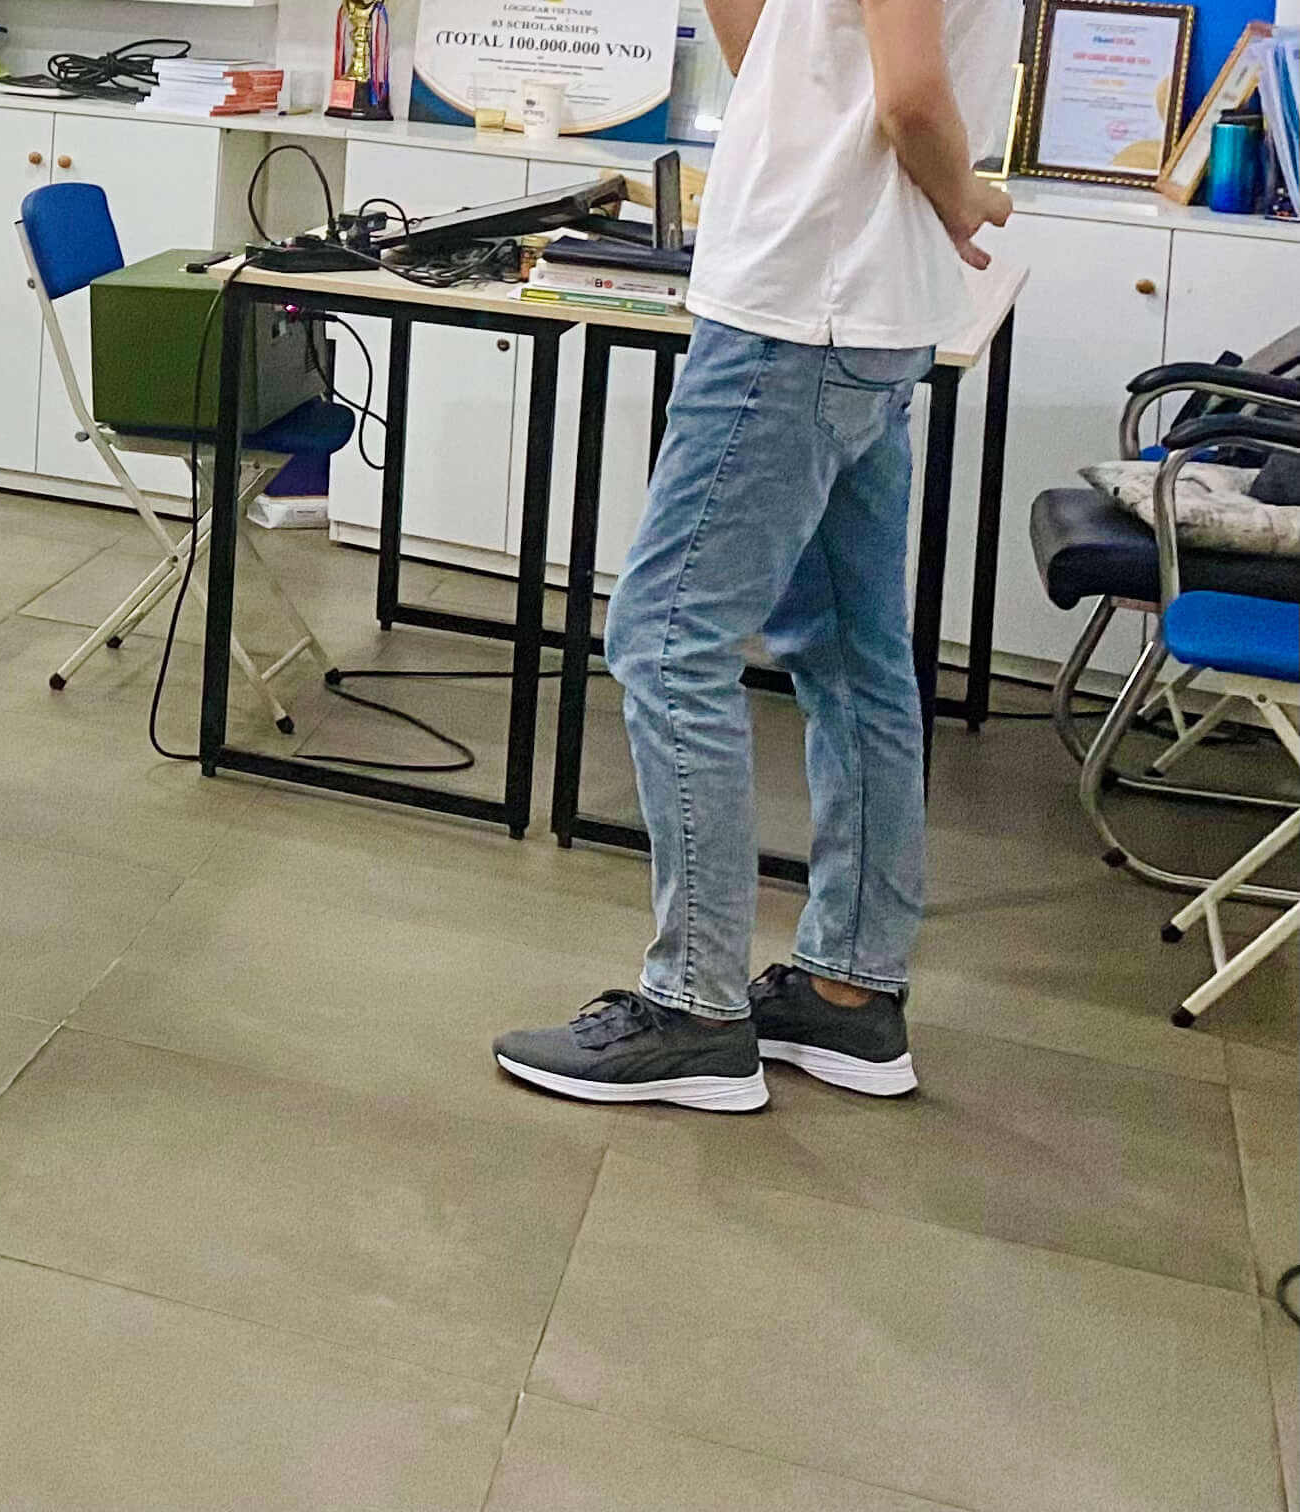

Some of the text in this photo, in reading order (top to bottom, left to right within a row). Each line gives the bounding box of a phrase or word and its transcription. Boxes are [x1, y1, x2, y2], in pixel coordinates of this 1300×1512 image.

[506, 20, 601, 36] SCHOLARSHIPS
[435, 29, 654, 62] (TOTAL 100.000.000 VND)
